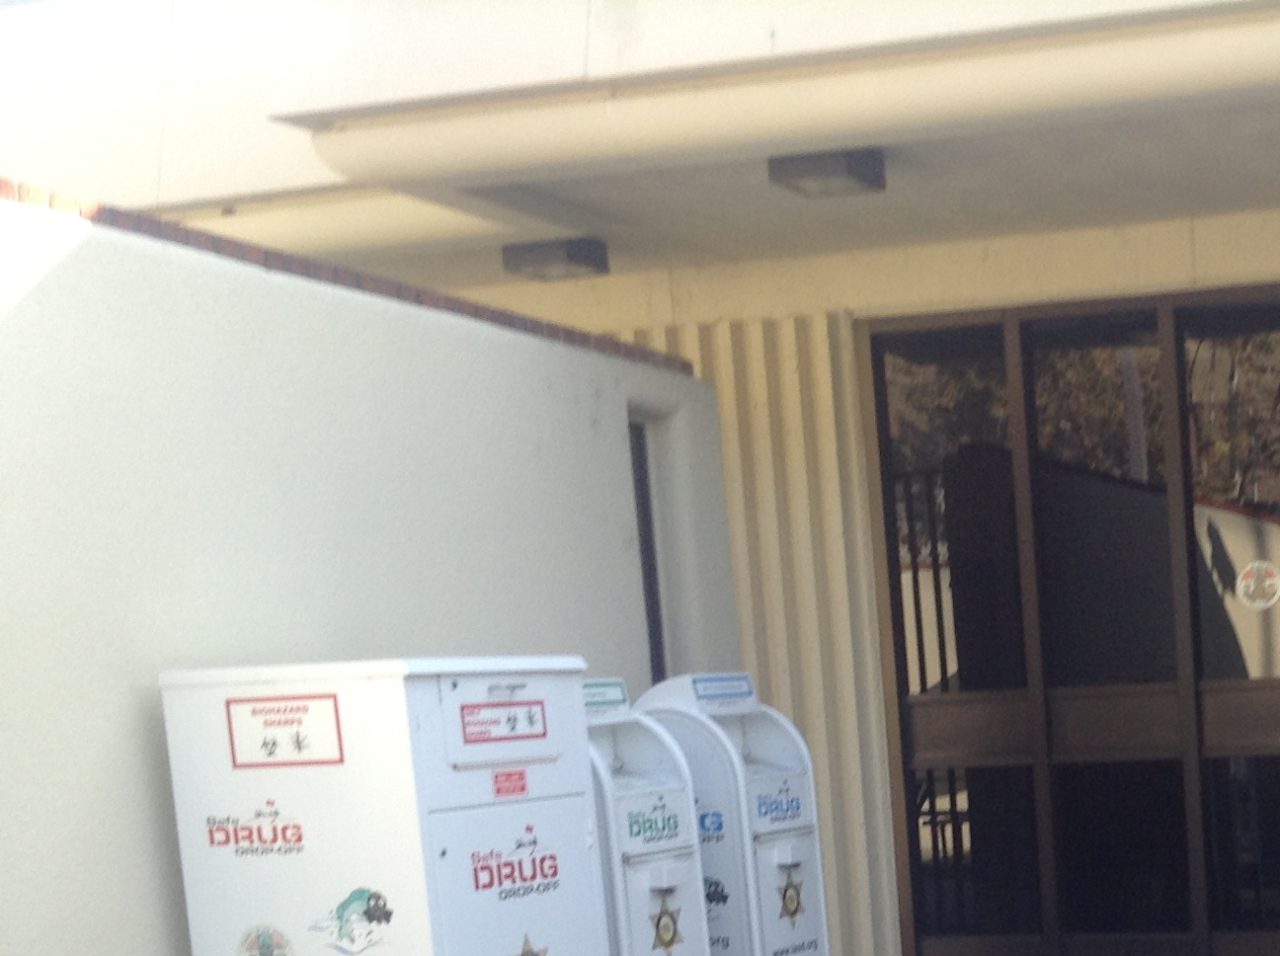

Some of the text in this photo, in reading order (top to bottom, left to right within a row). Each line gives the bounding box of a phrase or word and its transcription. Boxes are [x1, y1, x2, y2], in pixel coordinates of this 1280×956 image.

[757, 797, 801, 818] DRUG
[208, 824, 304, 847] DRUG
[629, 813, 679, 838] DRUG
[473, 853, 559, 892] DRUG
